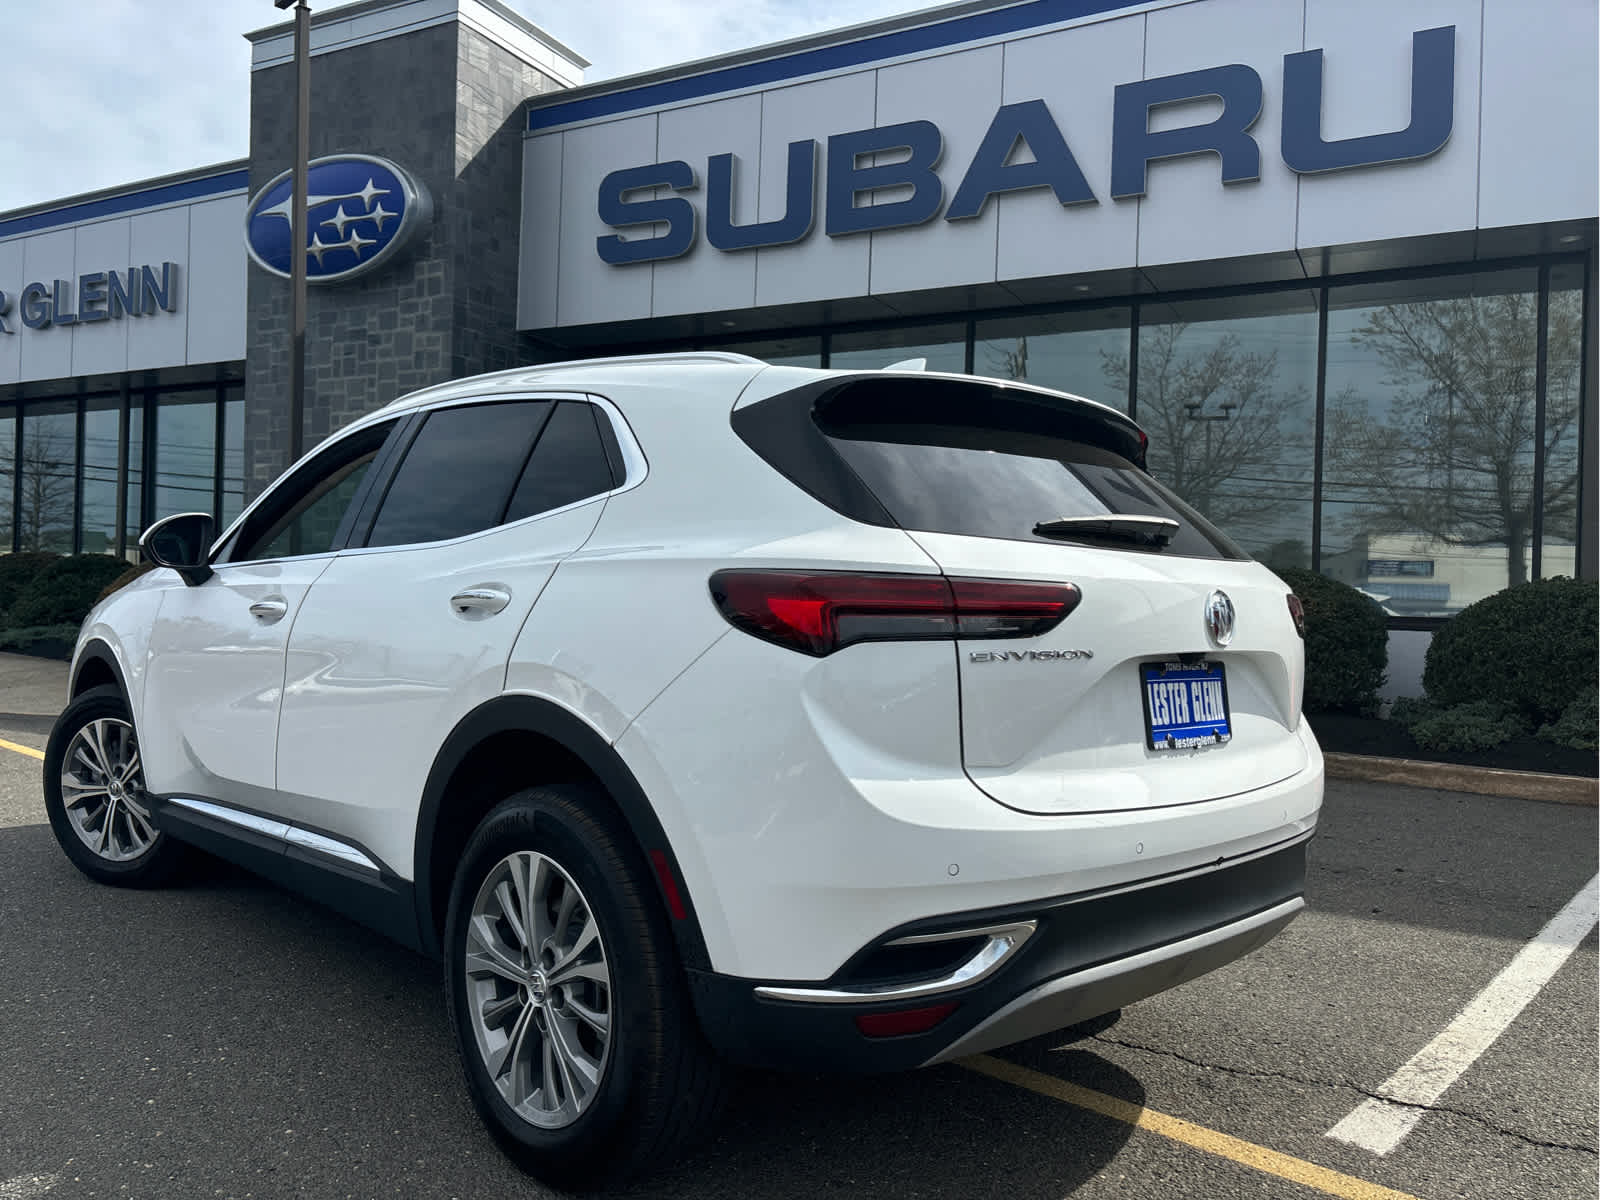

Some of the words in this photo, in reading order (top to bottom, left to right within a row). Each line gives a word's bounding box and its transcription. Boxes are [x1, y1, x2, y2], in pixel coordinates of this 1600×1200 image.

[597, 25, 1455, 265] SUBARU
[20, 262, 177, 330] GLENN
[969, 649, 1094, 663] ENVISION
[1147, 682, 1190, 726] LESTER
[1191, 681, 1226, 722] GLENN
[1175, 734, 1216, 749] lesterglenn
